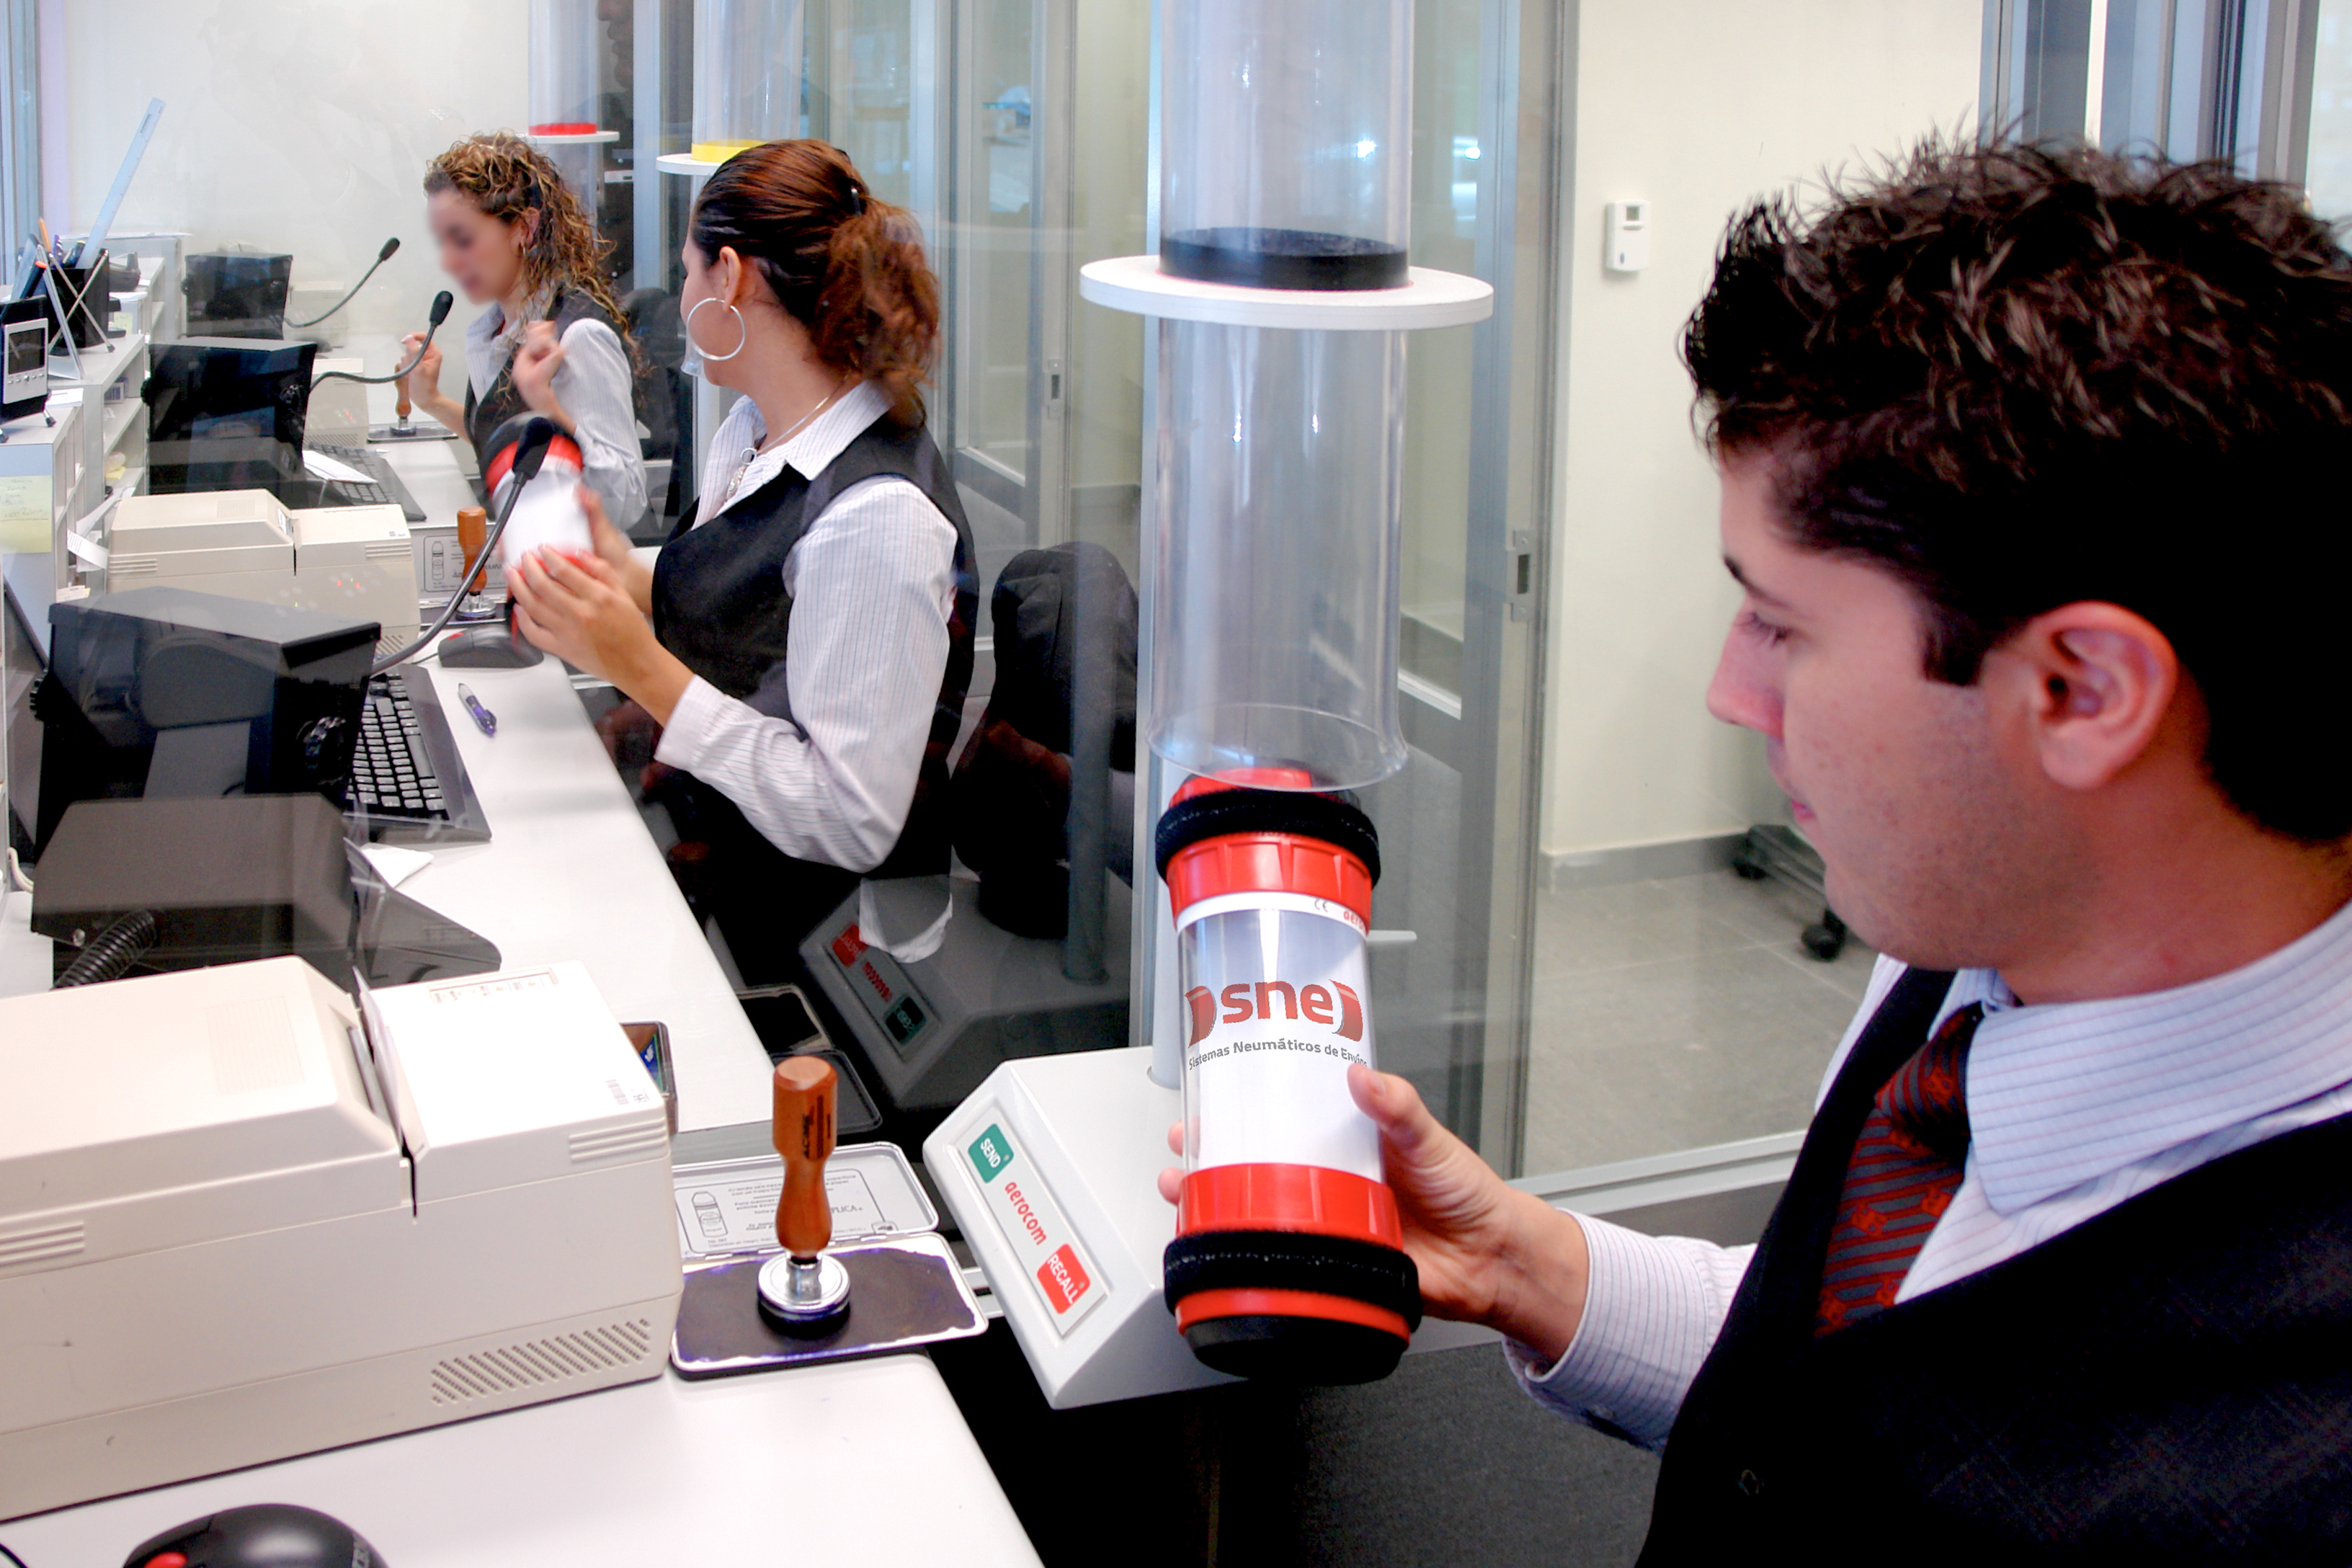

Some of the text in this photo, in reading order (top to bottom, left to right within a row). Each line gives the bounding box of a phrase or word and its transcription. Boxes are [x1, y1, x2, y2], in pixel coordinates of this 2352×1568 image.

[1189, 1046, 1230, 1070] Sistemas
[1233, 1038, 1321, 1054] Neumáticos
[1324, 1044, 1339, 1057] de
[980, 1137, 1002, 1169] SEND
[1004, 1182, 1047, 1246] aerocom
[1046, 1254, 1081, 1305] RECALL
